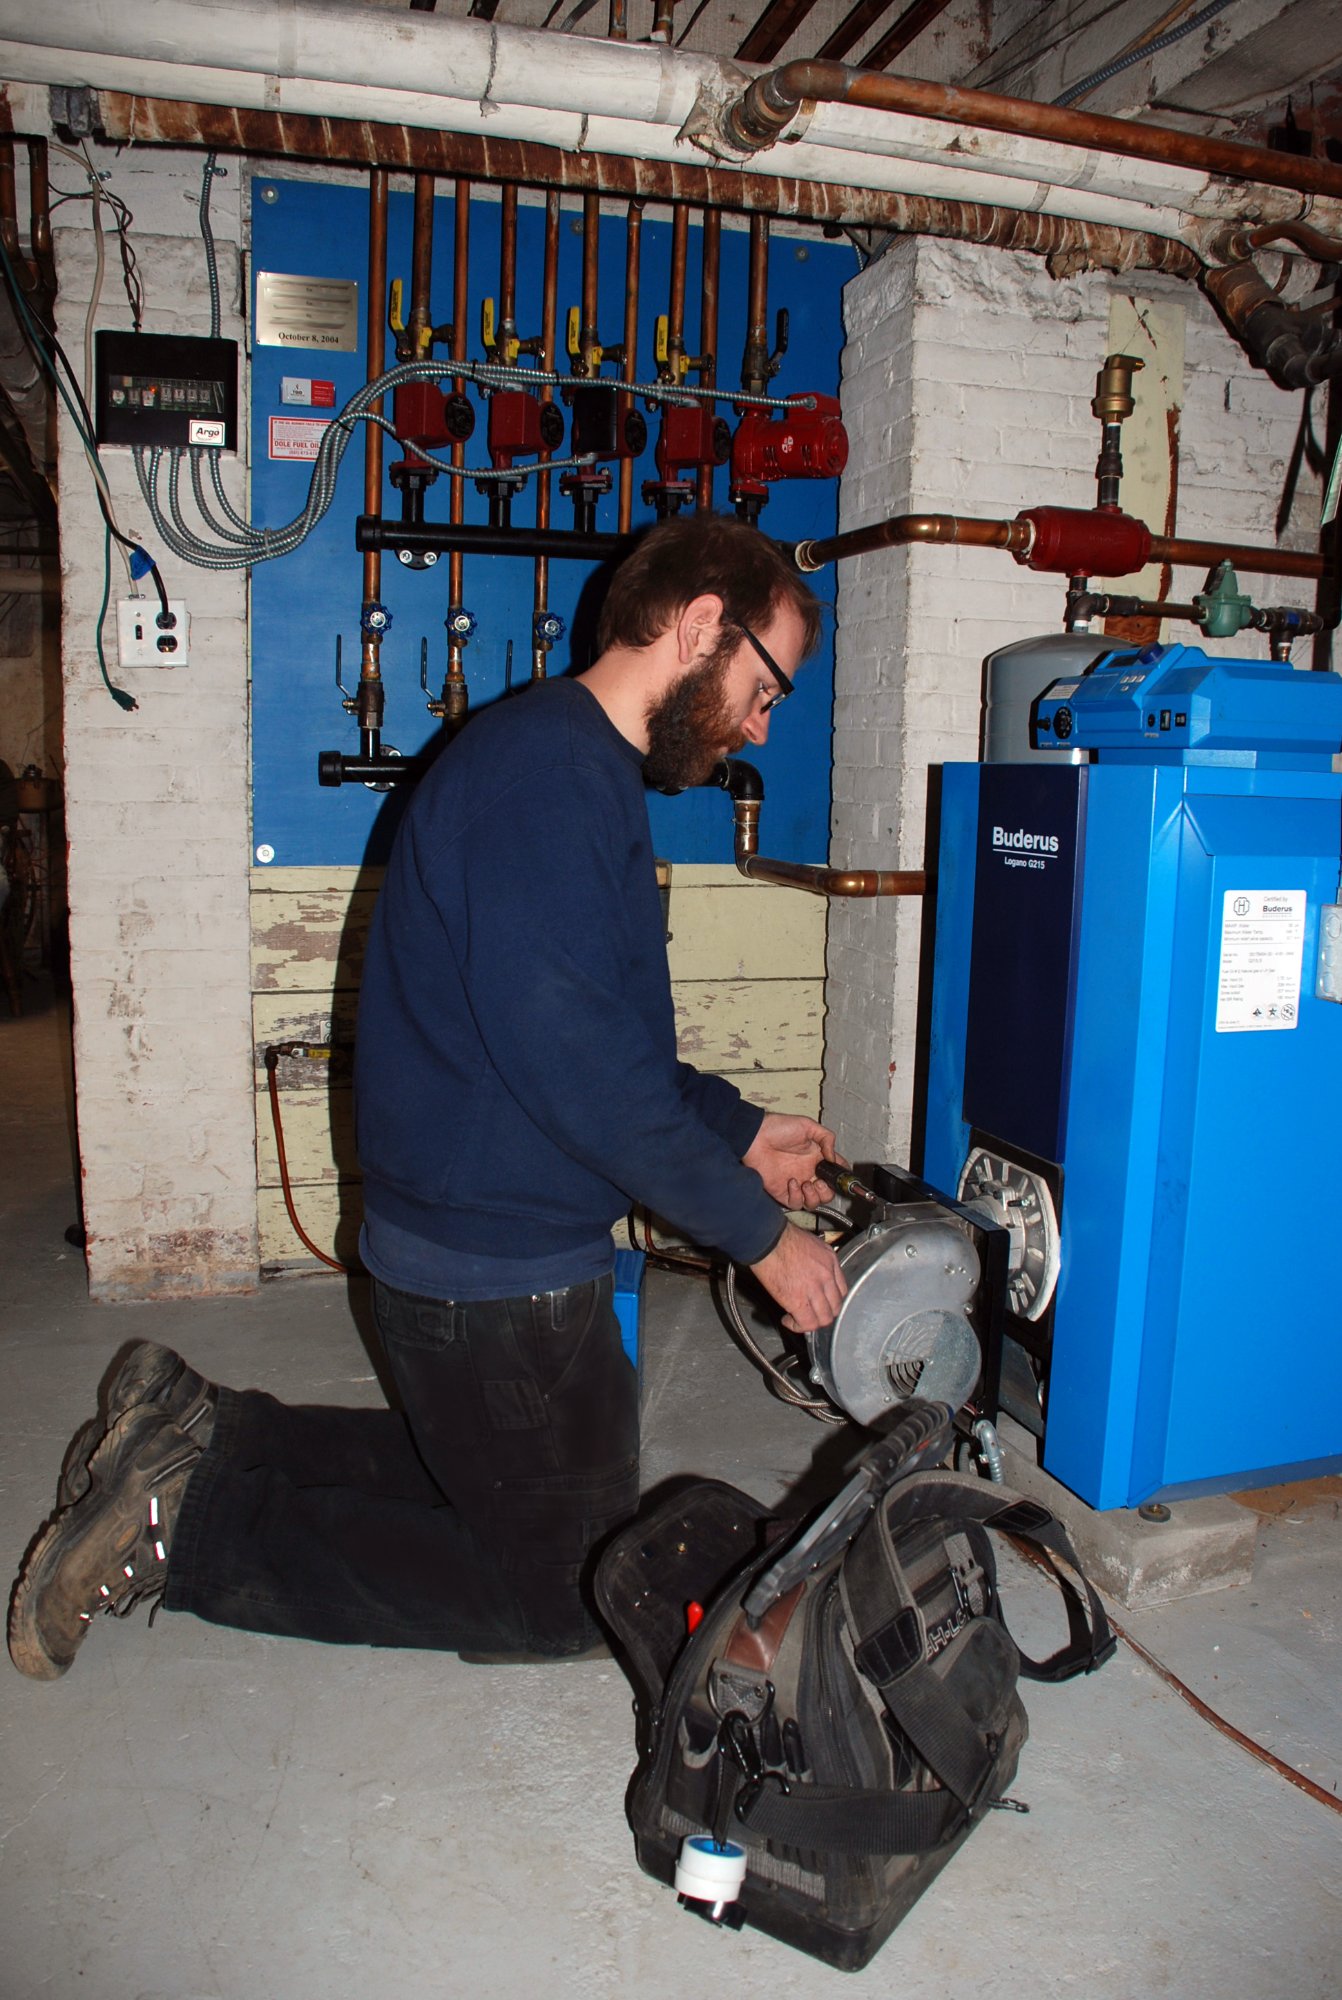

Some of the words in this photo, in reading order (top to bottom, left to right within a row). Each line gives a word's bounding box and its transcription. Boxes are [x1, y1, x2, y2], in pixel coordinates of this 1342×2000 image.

[278, 332, 309, 341] October
[311, 335, 319, 343] 8,
[321, 335, 339, 343] 2004
[196, 427, 220, 438] Argo
[992, 826, 1059, 852] Buderus
[1004, 856, 1027, 868] Logano
[1028, 859, 1045, 870] G215
